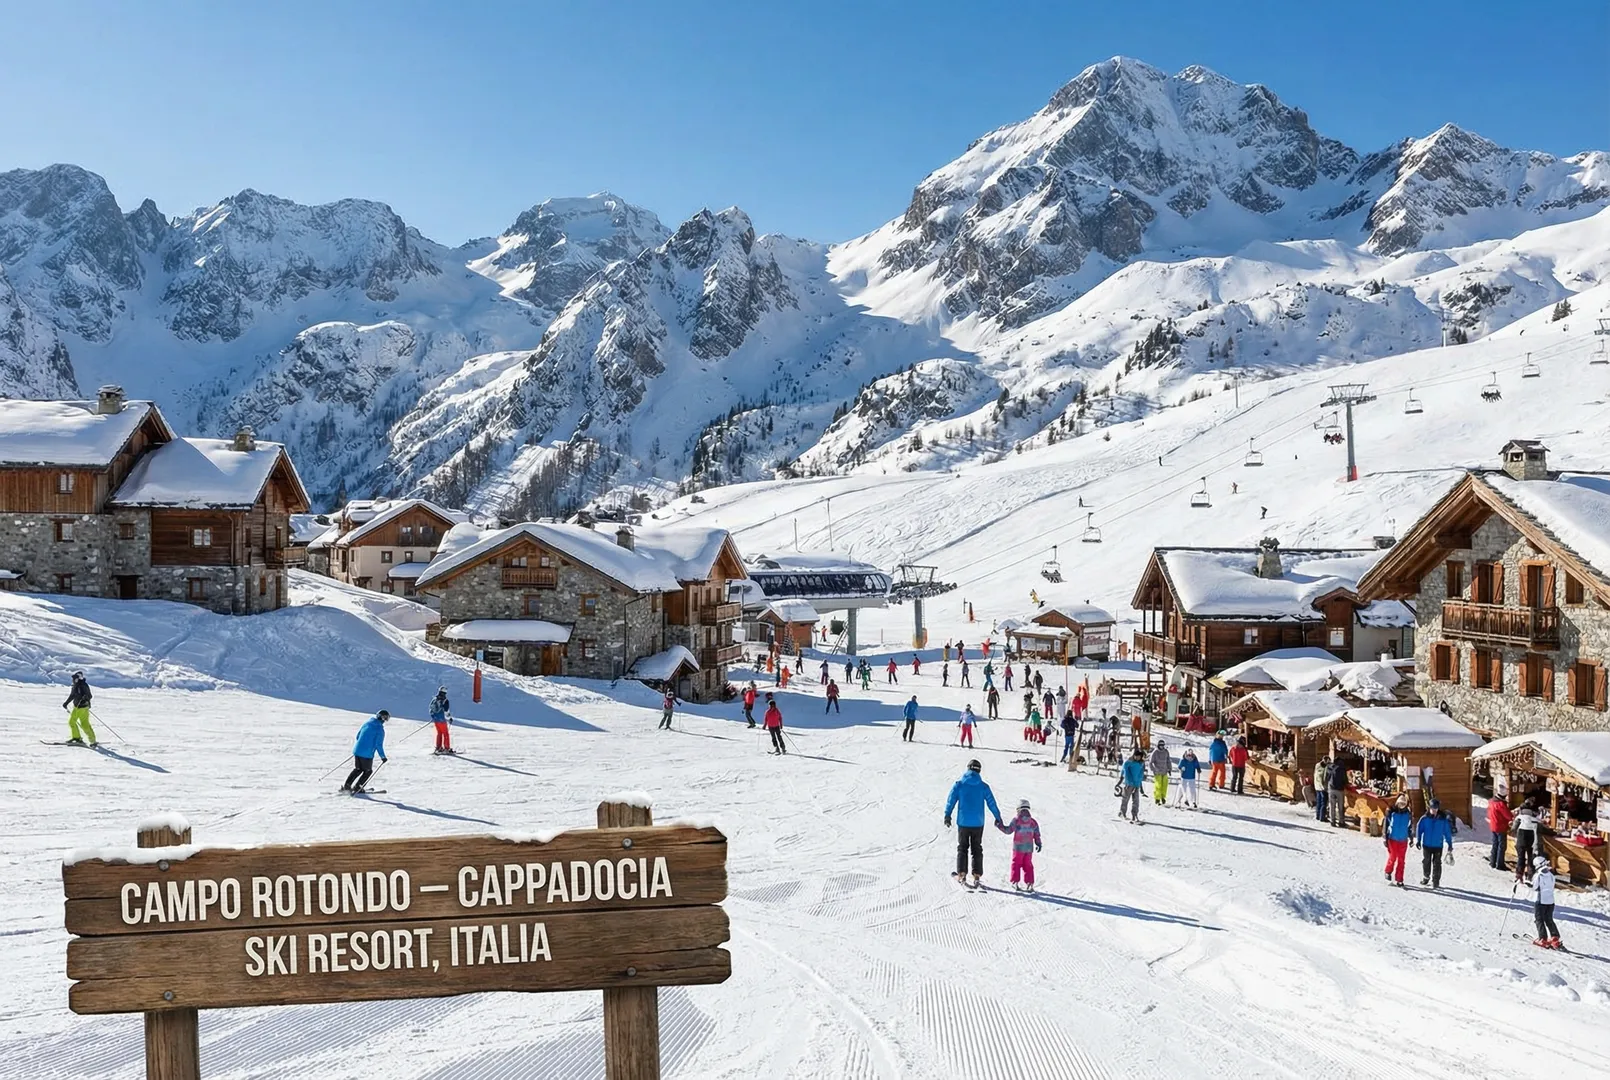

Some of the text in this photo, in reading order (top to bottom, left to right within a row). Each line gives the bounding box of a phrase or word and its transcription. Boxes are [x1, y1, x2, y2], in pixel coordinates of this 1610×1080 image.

[121, 877, 241, 925] CAMPO
[252, 869, 411, 918] ROTONDO
[458, 856, 673, 908] CAPPADOCIA
[245, 922, 552, 977] SKI RESORT, ITALIA
